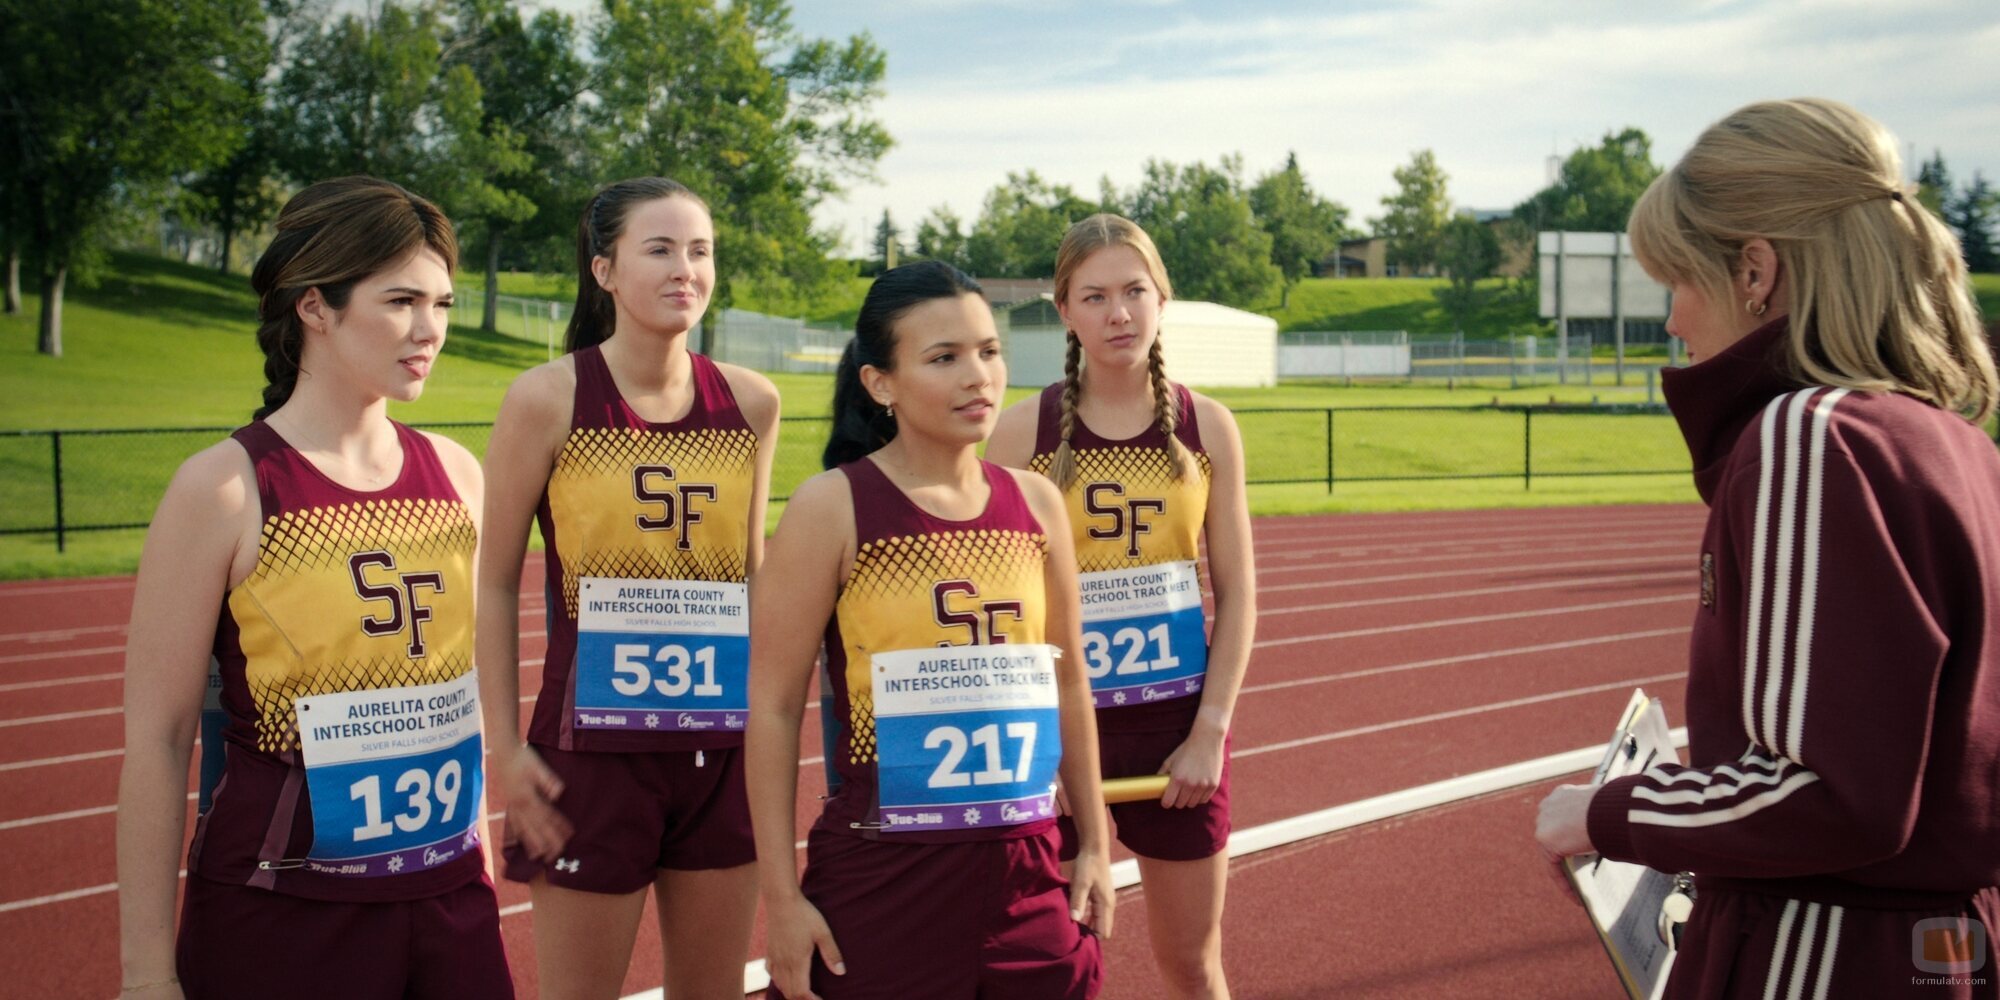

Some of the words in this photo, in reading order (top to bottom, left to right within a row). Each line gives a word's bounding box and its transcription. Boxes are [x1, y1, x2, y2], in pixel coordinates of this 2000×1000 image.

[632, 464, 717, 551] SF
[1083, 482, 1165, 559] SF
[1079, 577, 1129, 593] URELITA
[1132, 571, 1172, 586] COUNTY
[1133, 584, 1168, 599] TRACK
[347, 550, 444, 659] SF
[618, 588, 681, 600] AURELITA
[684, 589, 724, 602] COUNTY
[589, 601, 681, 614] INTERSCHOOL
[684, 603, 717, 616] TRACK
[719, 605, 741, 617] MEET
[625, 618, 650, 626] SILVER
[693, 620, 717, 628] SCHOOL
[1081, 623, 1180, 679] 321
[611, 644, 723, 697] 531
[918, 658, 988, 674] AURELITA
[991, 655, 1035, 670] COUNTY
[885, 674, 990, 693] INTERSCHOOL
[993, 674, 1027, 687] TRACK
[348, 698, 424, 719] AURELITA
[428, 688, 466, 710] COUNTY
[313, 715, 426, 741] INTERSCHOOL
[428, 708, 460, 728] TRACK
[460, 698, 476, 718] MEET
[579, 713, 627, 726] True-Blue
[361, 742, 389, 752] SILVER
[391, 738, 417, 748] FALLS
[418, 735, 438, 745] HIGH
[438, 729, 459, 741] SCHOOL
[923, 722, 1037, 788] 217
[350, 759, 462, 842] 139
[886, 813, 943, 825] True-Blue
[310, 863, 367, 875] True-Blue
